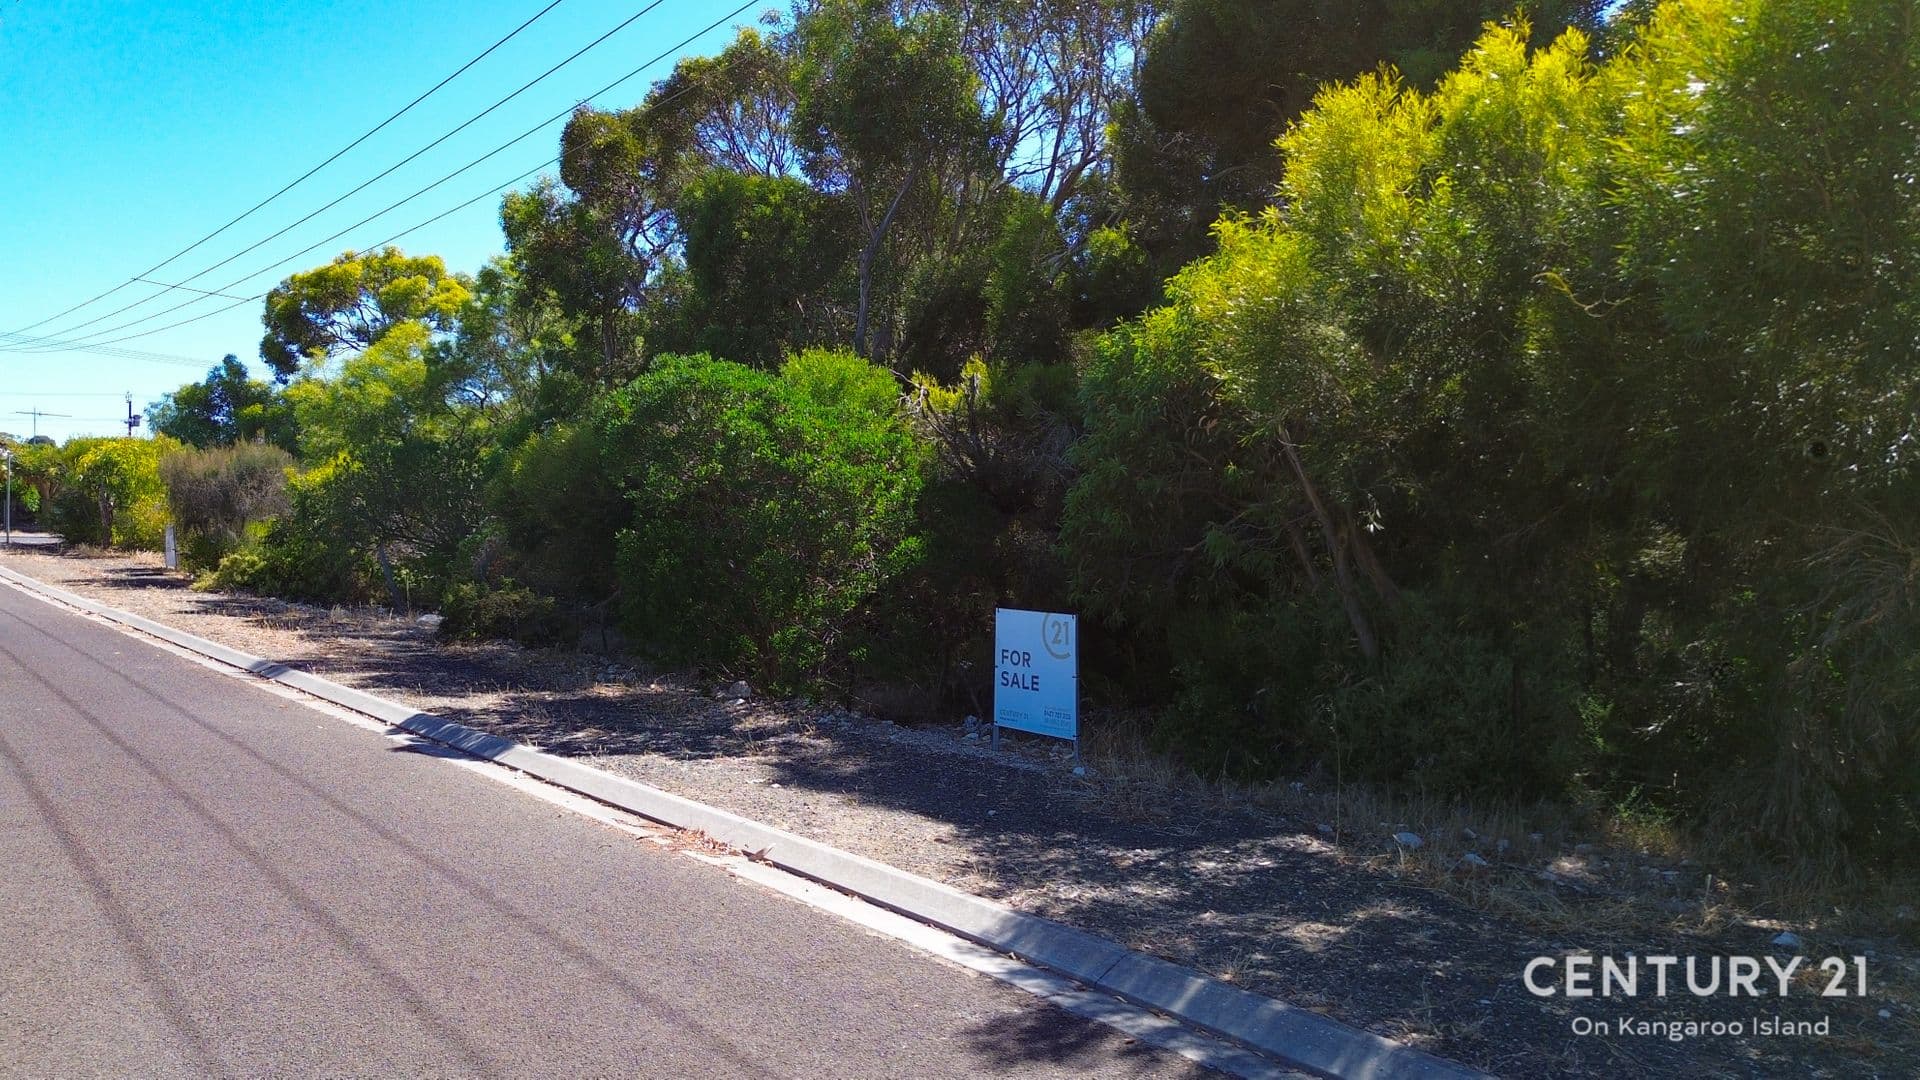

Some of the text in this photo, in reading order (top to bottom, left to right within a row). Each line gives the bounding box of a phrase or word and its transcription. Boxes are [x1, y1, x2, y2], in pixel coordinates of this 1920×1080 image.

[1051, 620, 1070, 646] 21
[1001, 648, 1031, 668] FOR
[1000, 670, 1040, 692] SALE
